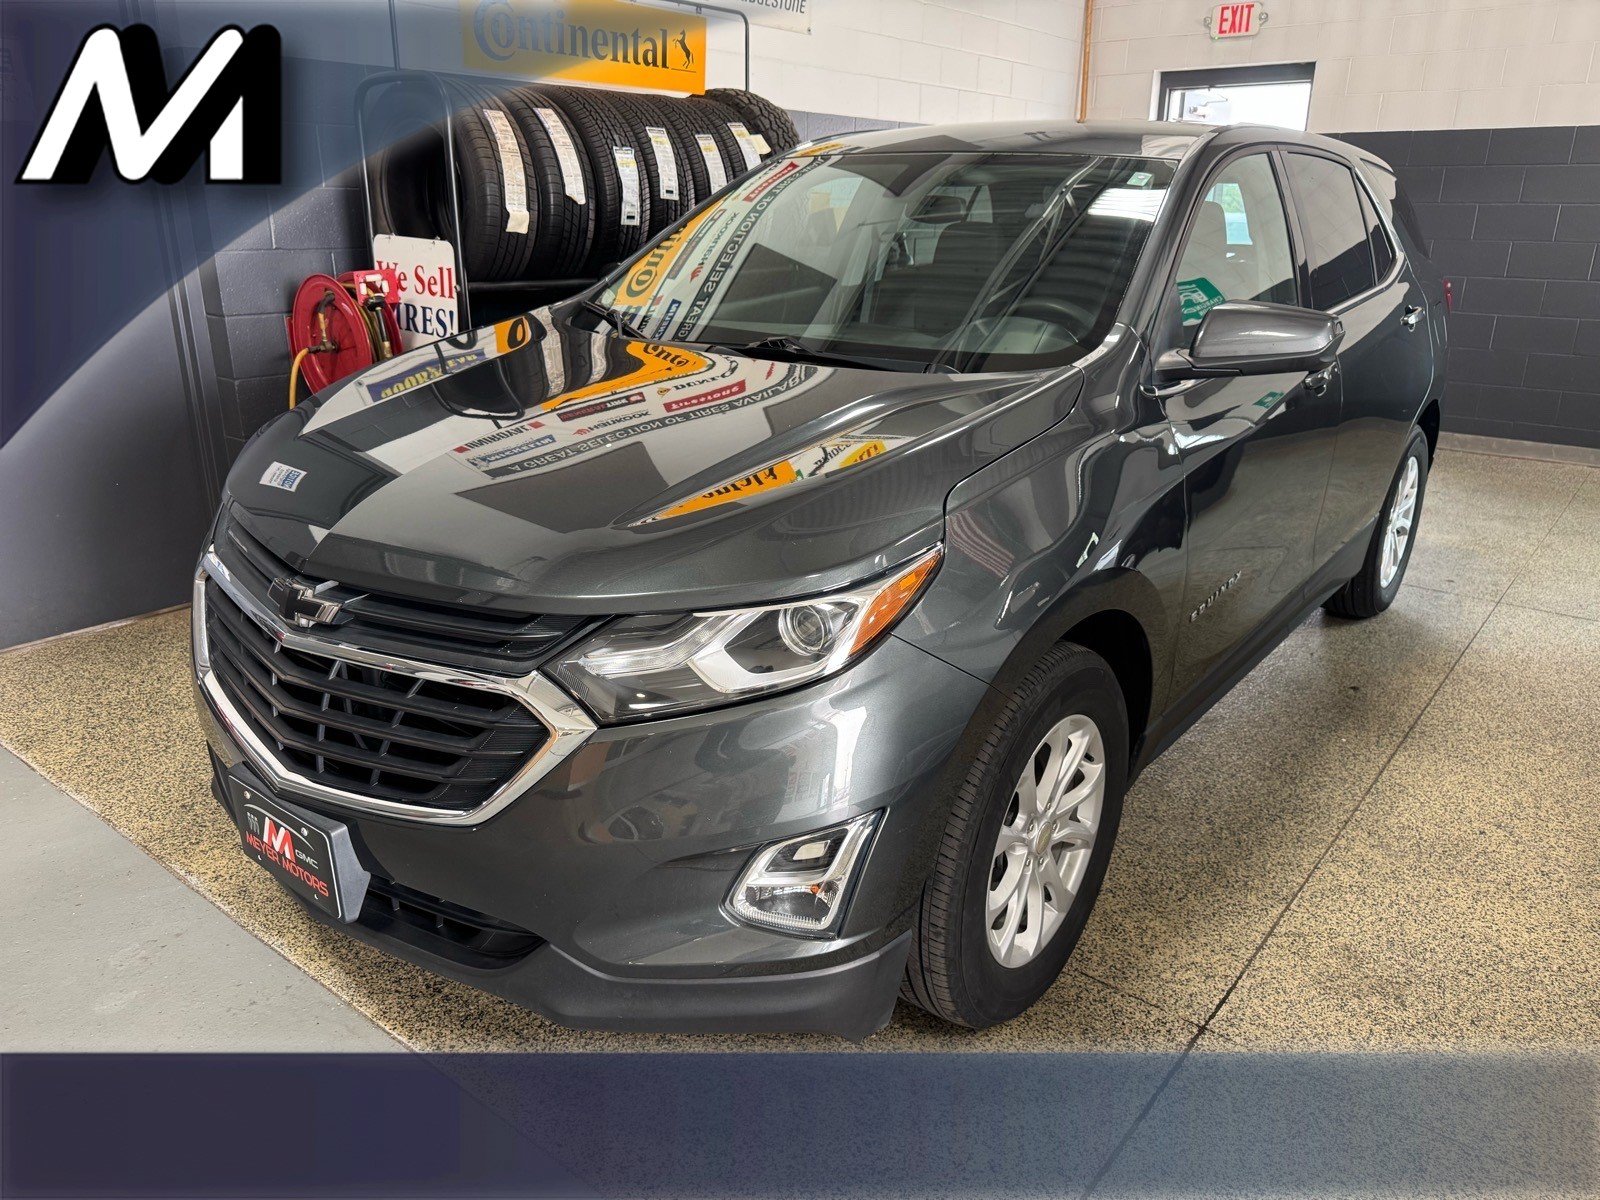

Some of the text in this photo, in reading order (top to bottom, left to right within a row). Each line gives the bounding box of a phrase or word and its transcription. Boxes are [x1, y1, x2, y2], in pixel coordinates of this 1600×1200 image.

[473, 0, 670, 69] Continental
[1218, 4, 1254, 34] EXIT
[414, 265, 455, 299] Sell
[396, 302, 455, 338] IRES!
[245, 830, 330, 898] MEYER MOTORS
[294, 848, 320, 870] GMC
